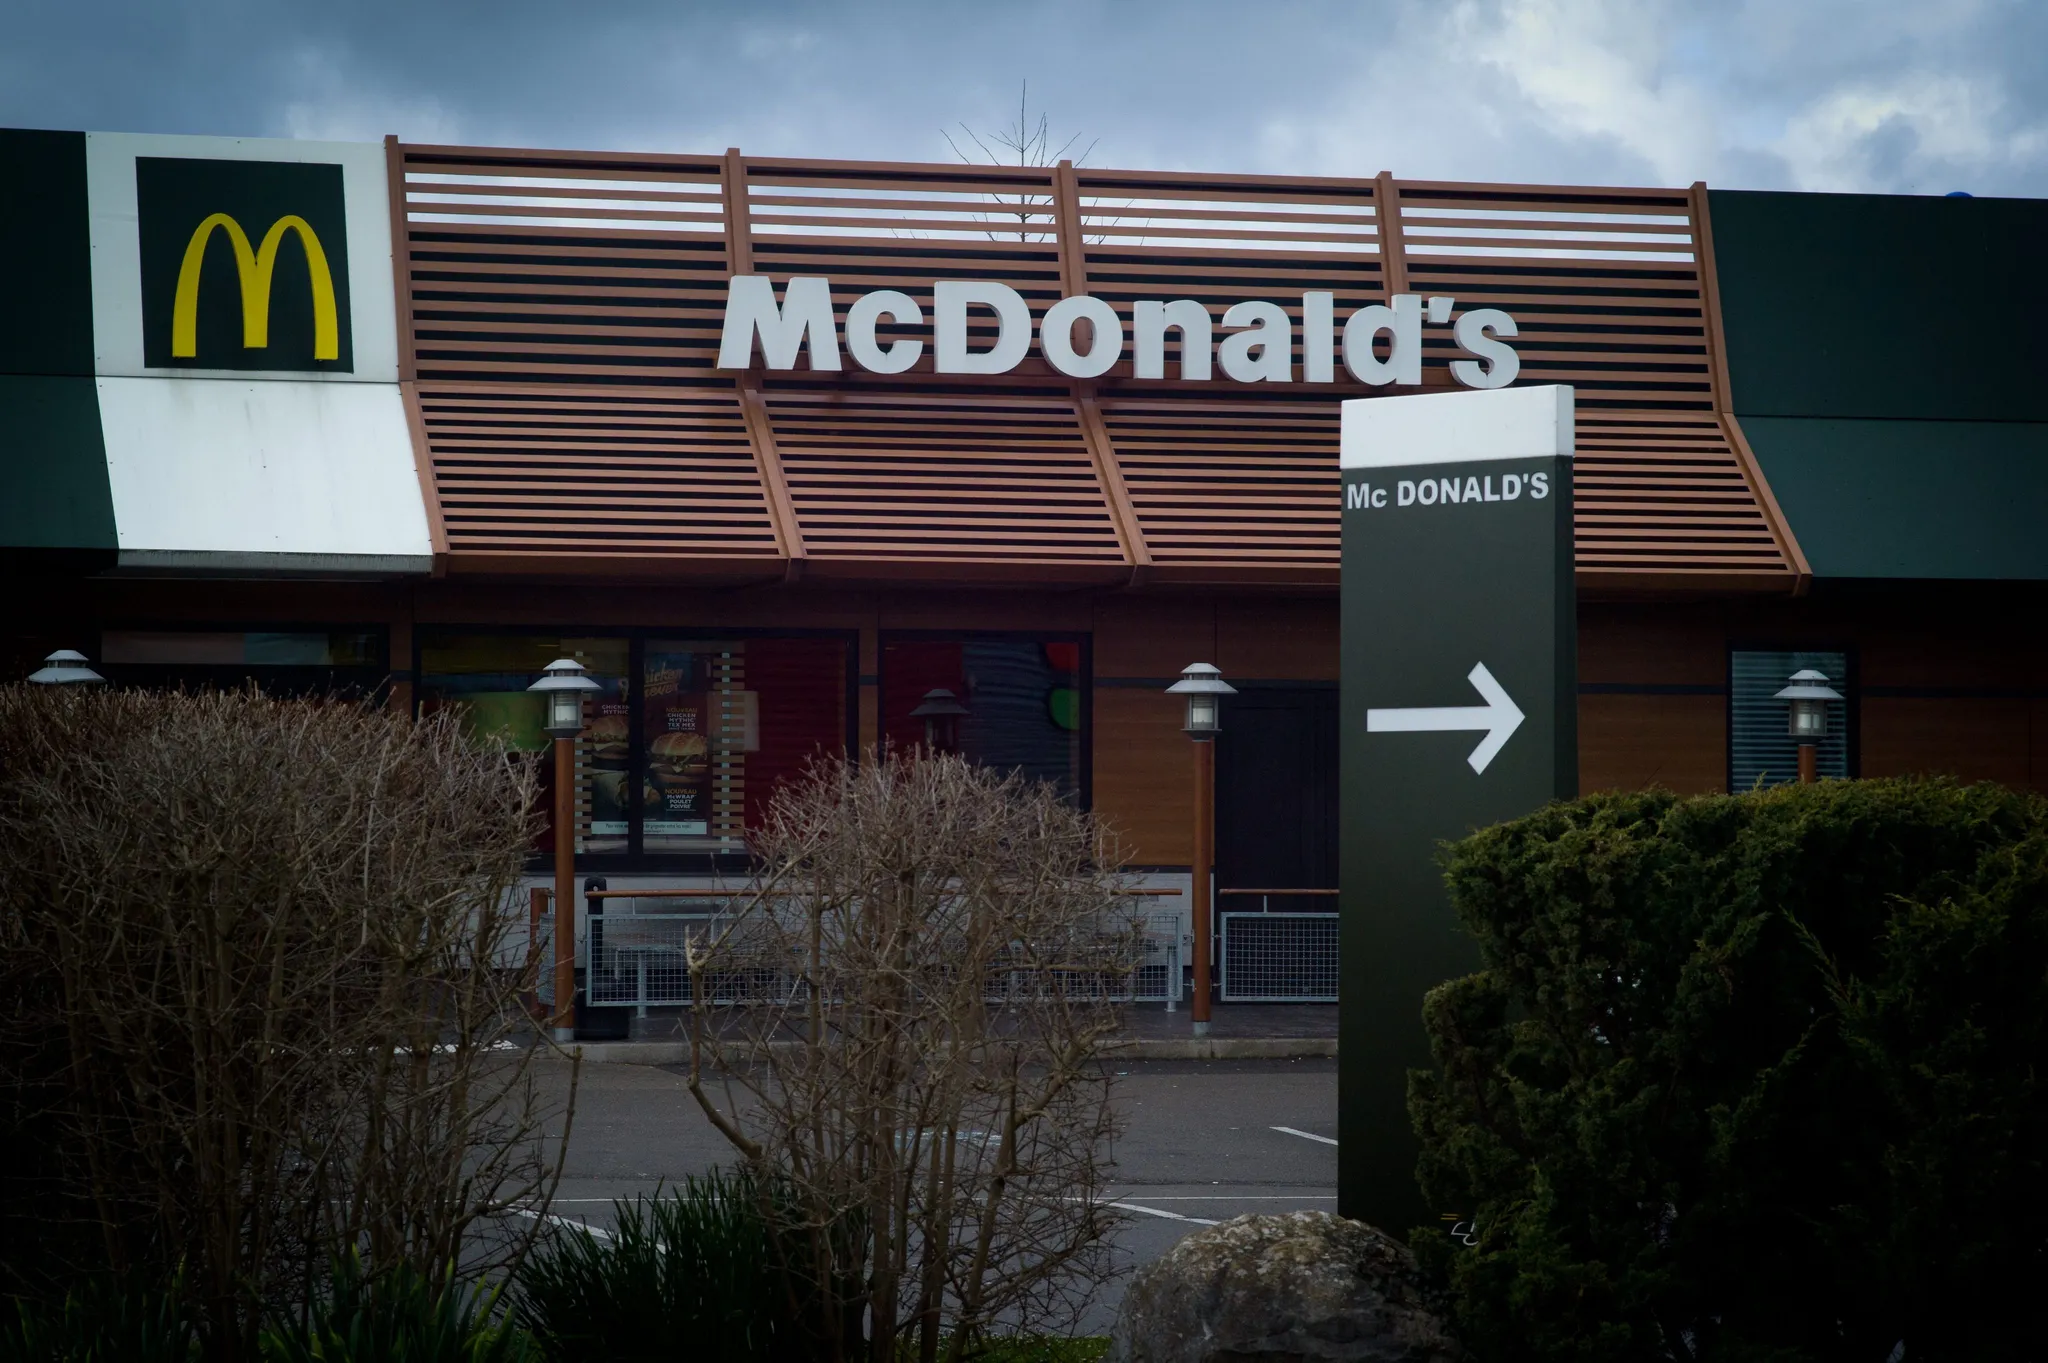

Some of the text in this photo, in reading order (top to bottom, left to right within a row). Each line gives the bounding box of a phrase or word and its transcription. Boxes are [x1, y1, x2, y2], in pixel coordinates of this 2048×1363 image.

[715, 274, 1521, 390] McDonald's
[1346, 471, 1550, 510] Mc DONALD'S
